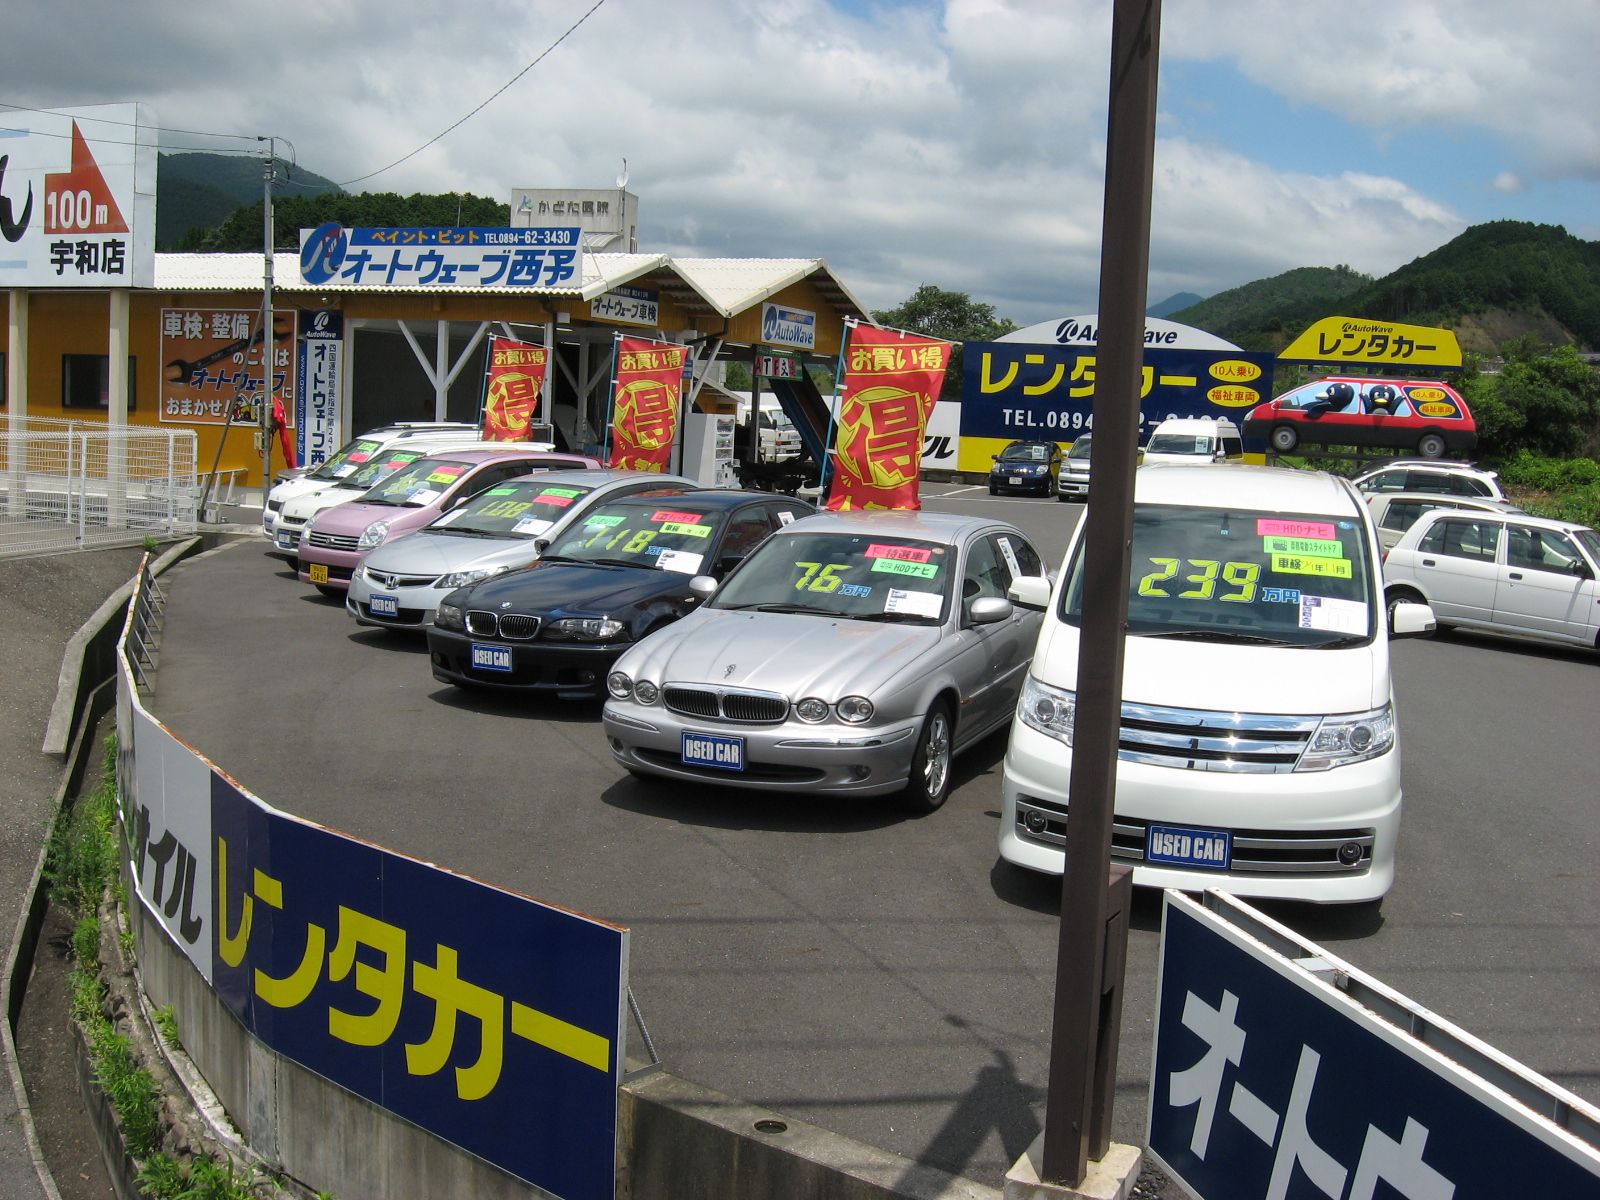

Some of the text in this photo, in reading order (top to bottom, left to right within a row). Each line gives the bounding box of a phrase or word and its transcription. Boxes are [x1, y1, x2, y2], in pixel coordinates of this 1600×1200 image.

[50, 238, 126, 275] 宇和店
[341, 249, 577, 285] オートウェーブ西予
[592, 297, 657, 322] オートウェーブ車検
[306, 331, 336, 339] AutoWave
[774, 323, 813, 344] AutoWave
[1077, 325, 1177, 344] Auave
[1351, 323, 1393, 334] AutoWave
[233, 348, 289, 367] のこは
[495, 350, 545, 365] お買い得
[1319, 333, 1436, 358] レンタカー
[621, 351, 682, 370] お買い得
[852, 346, 943, 371] お買い得
[1214, 365, 1256, 377] 10人乗り
[795, 561, 853, 593] 76
[894, 563, 930, 575] HDDナビ
[1138, 557, 1300, 604] 239 万円
[474, 650, 510, 673] USED CAR
[685, 738, 740, 764] USED CAR
[1152, 832, 1224, 861] USED CAR
[219, 836, 610, 1100] レンタカー
